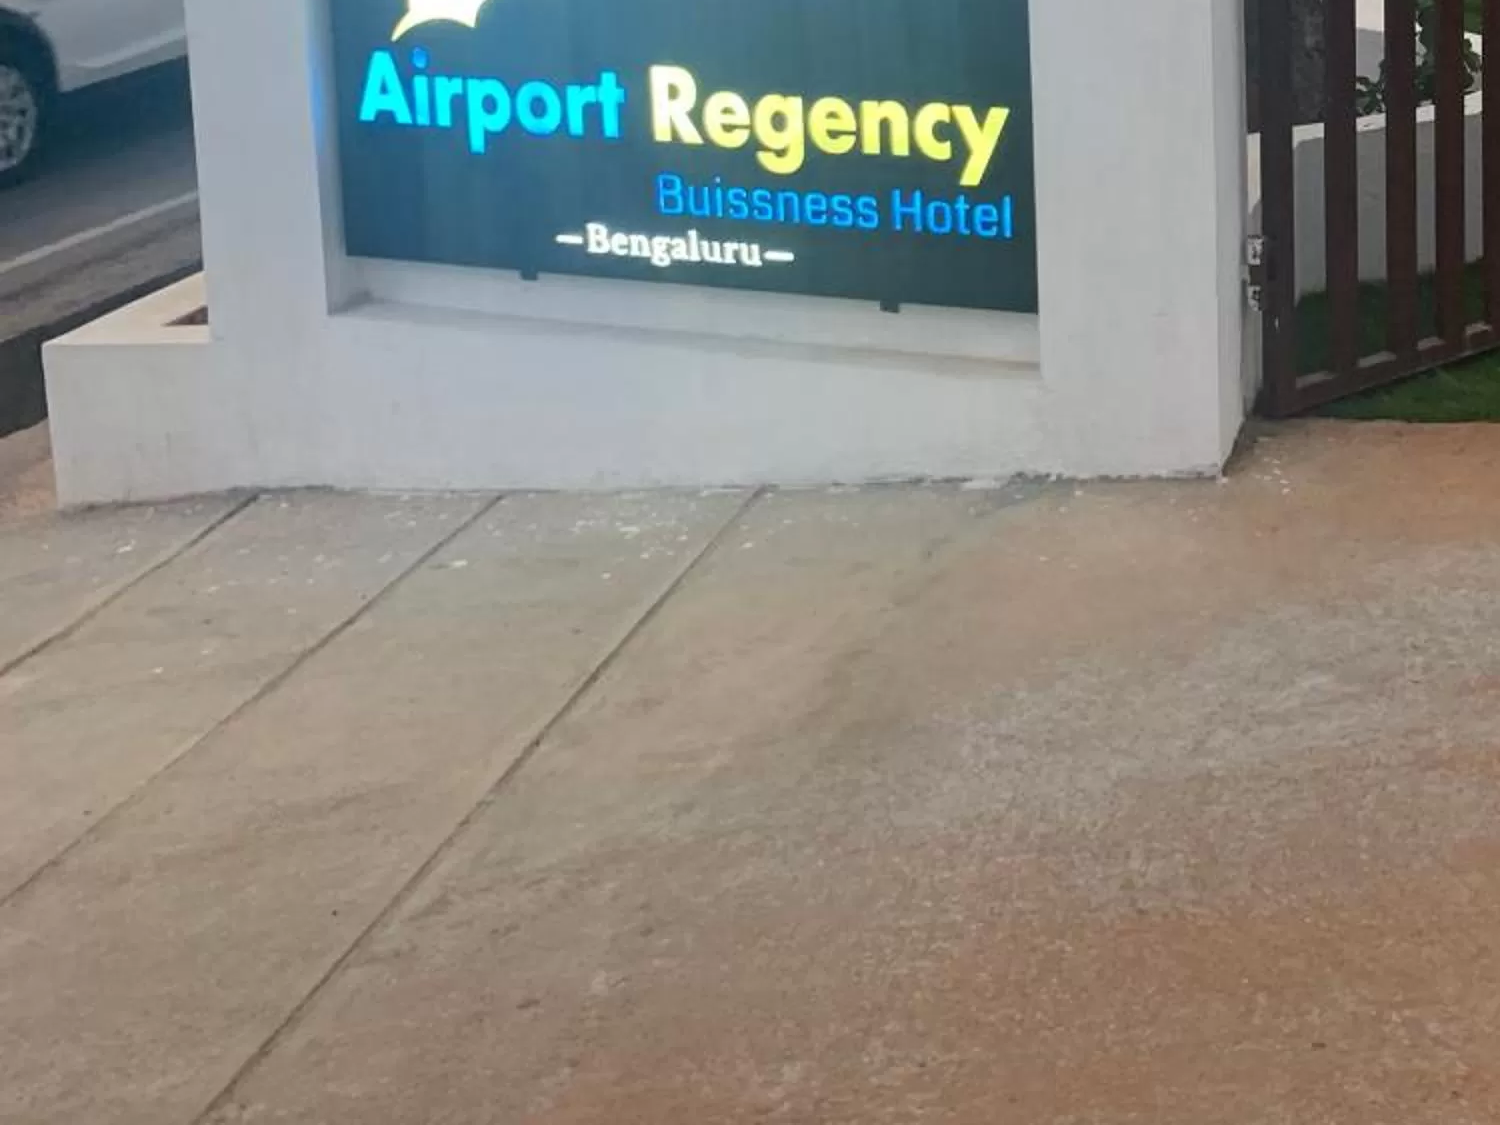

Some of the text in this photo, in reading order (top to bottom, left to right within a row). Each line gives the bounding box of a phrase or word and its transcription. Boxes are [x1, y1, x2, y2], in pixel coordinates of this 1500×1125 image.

[359, 48, 1009, 186] Airport Regency
[656, 173, 1013, 238] Buissness Hotel
